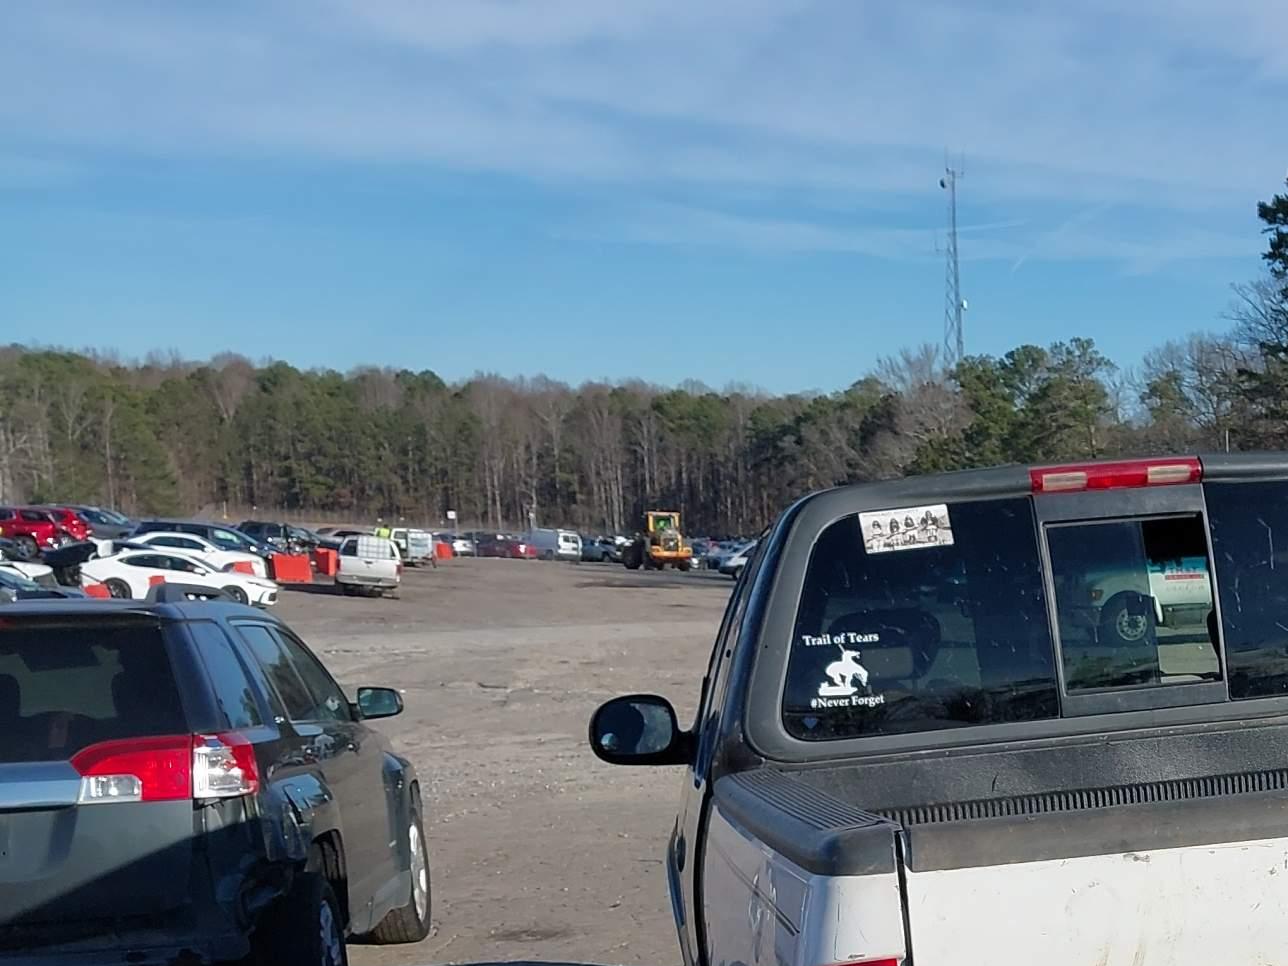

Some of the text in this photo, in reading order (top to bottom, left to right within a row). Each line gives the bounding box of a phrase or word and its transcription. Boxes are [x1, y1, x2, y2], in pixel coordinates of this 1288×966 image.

[802, 632, 879, 646] Trail of Tears
[810, 694, 885, 709] #Never Forget
